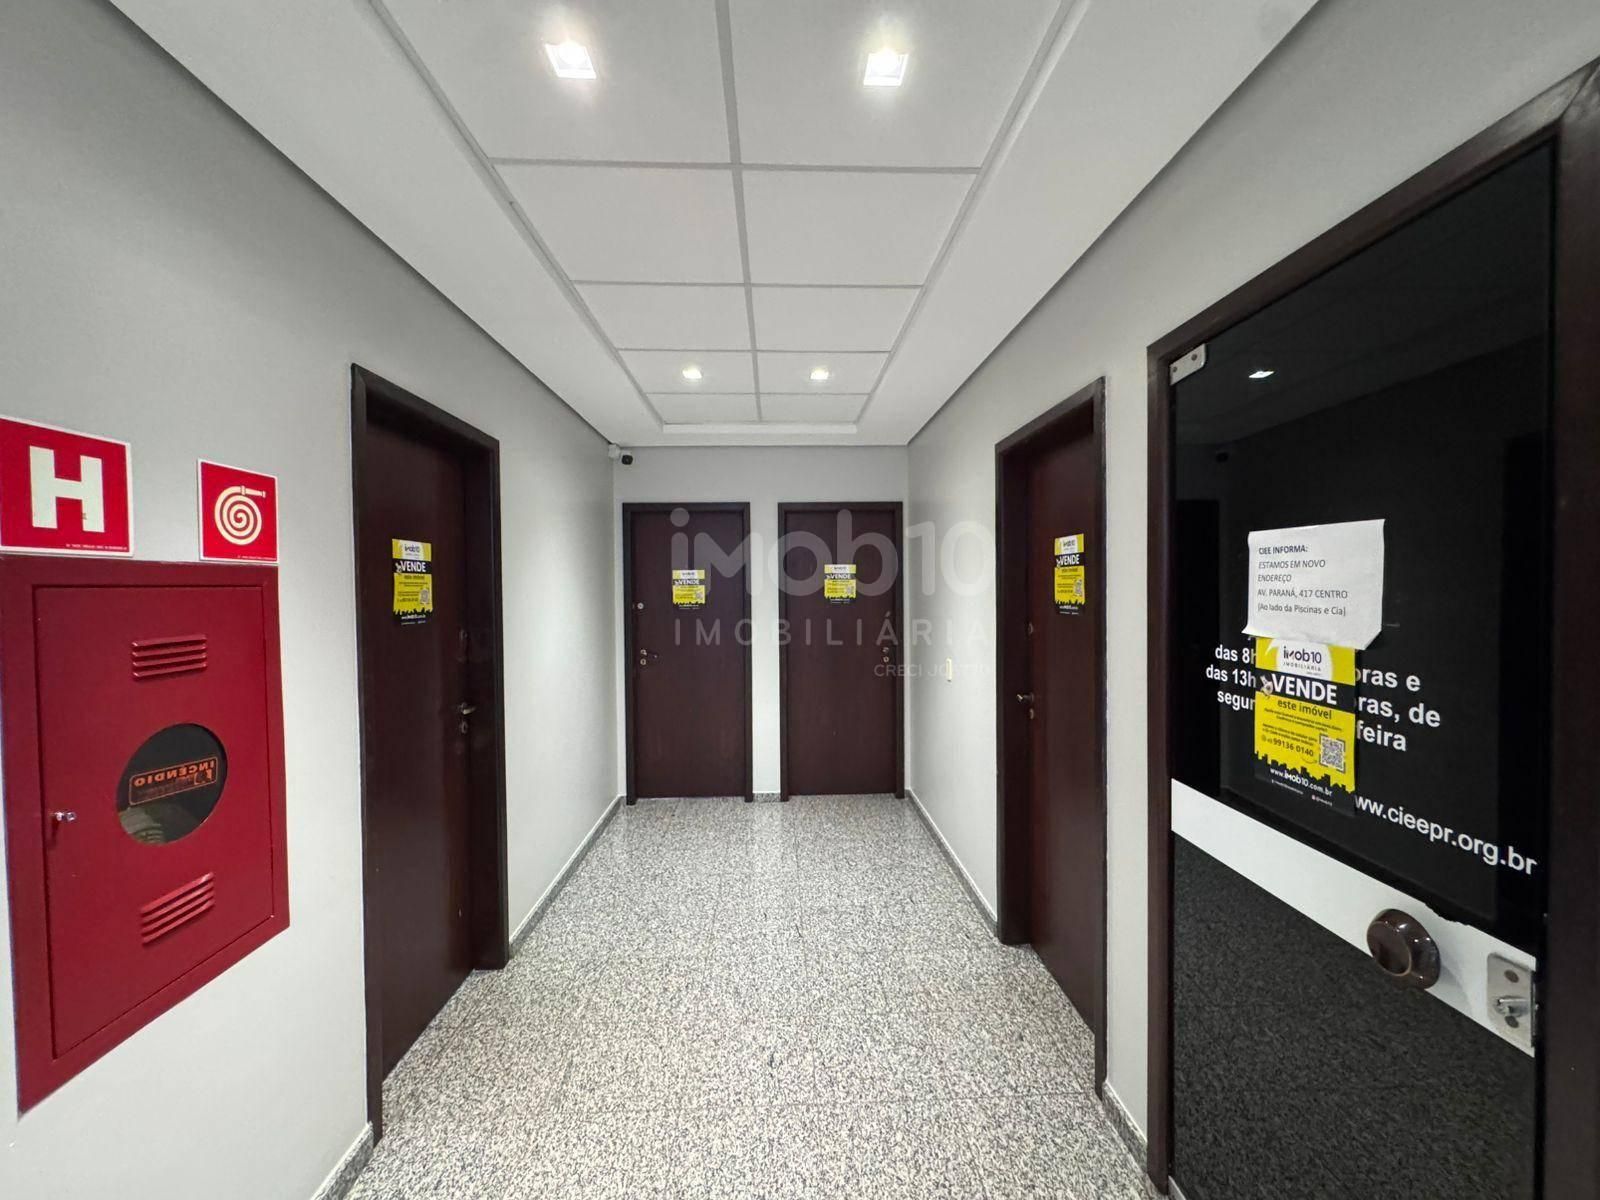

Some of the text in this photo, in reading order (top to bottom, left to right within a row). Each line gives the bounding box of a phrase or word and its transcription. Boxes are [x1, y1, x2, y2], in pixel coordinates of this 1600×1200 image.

[29, 445, 105, 533] H
[1258, 545, 1308, 555] CIEE INFORMA:
[400, 560, 427, 573] VENDE
[1060, 554, 1080, 566] VENDE
[1258, 559, 1326, 569] ESTAMOS EM NOVO
[1257, 574, 1292, 583] ENDEREÇO
[1257, 588, 1268, 597] AV.
[1299, 589, 1313, 598] 417
[1314, 589, 1348, 599] CENTRO
[1268, 603, 1283, 612] lado
[1284, 604, 1293, 613] da
[1294, 604, 1322, 615] Piscinas
[1331, 606, 1347, 617] Cia)
[1215, 644, 1238, 662] das
[1206, 664, 1257, 688] das 13h
[1405, 675, 1421, 692] e
[1271, 673, 1337, 705] VENDE
[1277, 700, 1297, 711] este
[1299, 702, 1332, 720] imóvel
[1408, 703, 1441, 728] de
[1273, 738, 1294, 751] 99136
[1295, 744, 1314, 757] 0140
[1354, 795, 1537, 875] ww.cieepr.org.br
